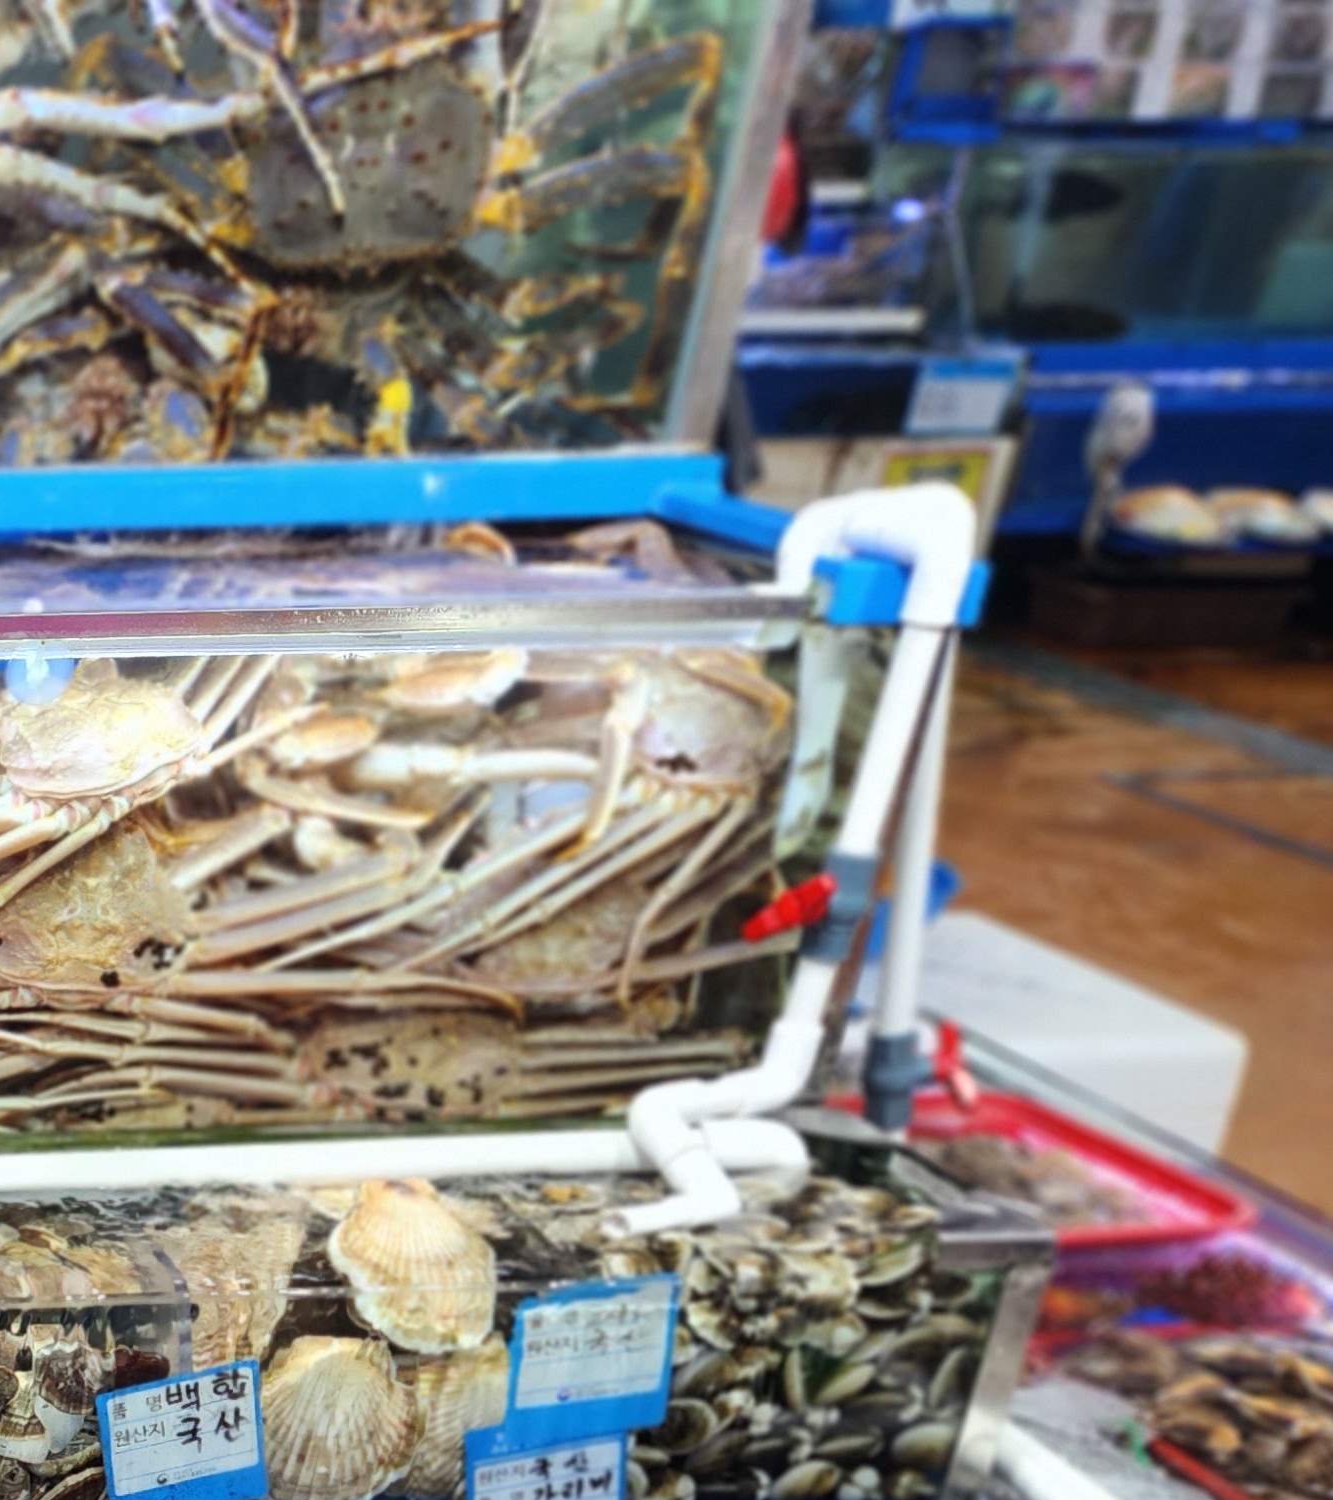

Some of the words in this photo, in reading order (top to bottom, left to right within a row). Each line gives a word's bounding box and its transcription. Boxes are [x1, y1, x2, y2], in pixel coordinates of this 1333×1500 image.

[165, 1368, 250, 1412] 백합
[113, 1421, 167, 1448] 원산지
[175, 1404, 248, 1454] 국산
